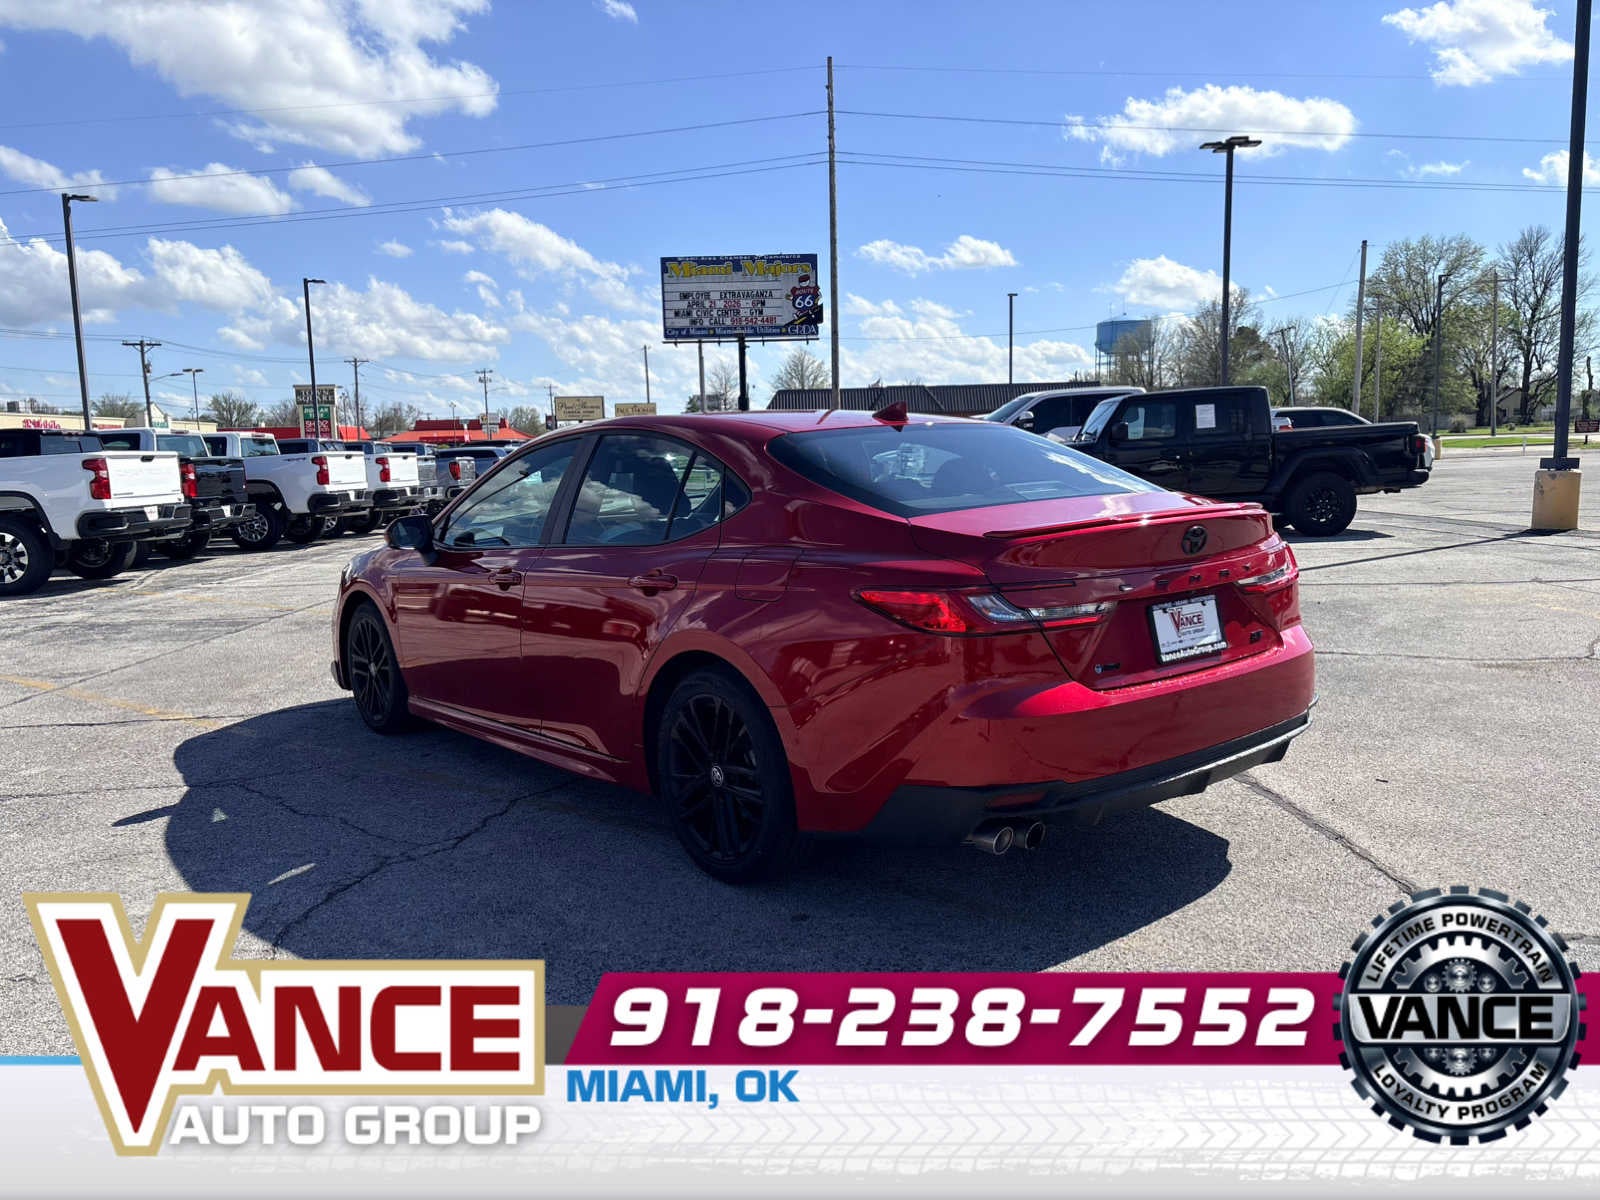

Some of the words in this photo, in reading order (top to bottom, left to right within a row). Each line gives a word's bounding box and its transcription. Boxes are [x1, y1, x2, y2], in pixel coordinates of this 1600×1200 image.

[665, 261, 733, 279] Miami
[741, 259, 812, 278] Majors
[679, 292, 711, 300] EMPLOYEE
[719, 291, 774, 300] EXTRAVAGANZA
[709, 300, 716, 308] 21
[723, 300, 742, 308] 2026
[751, 300, 766, 308] 6PM
[795, 295, 814, 308] 66
[674, 309, 693, 318] MIAMI
[695, 309, 714, 317] CIVIC
[716, 309, 741, 317] CENTER
[749, 308, 764, 316] GYM
[708, 318, 725, 326] CALL
[1169, 609, 1203, 632] VANCE
[1161, 641, 1227, 662] VanceAutoGroup.com
